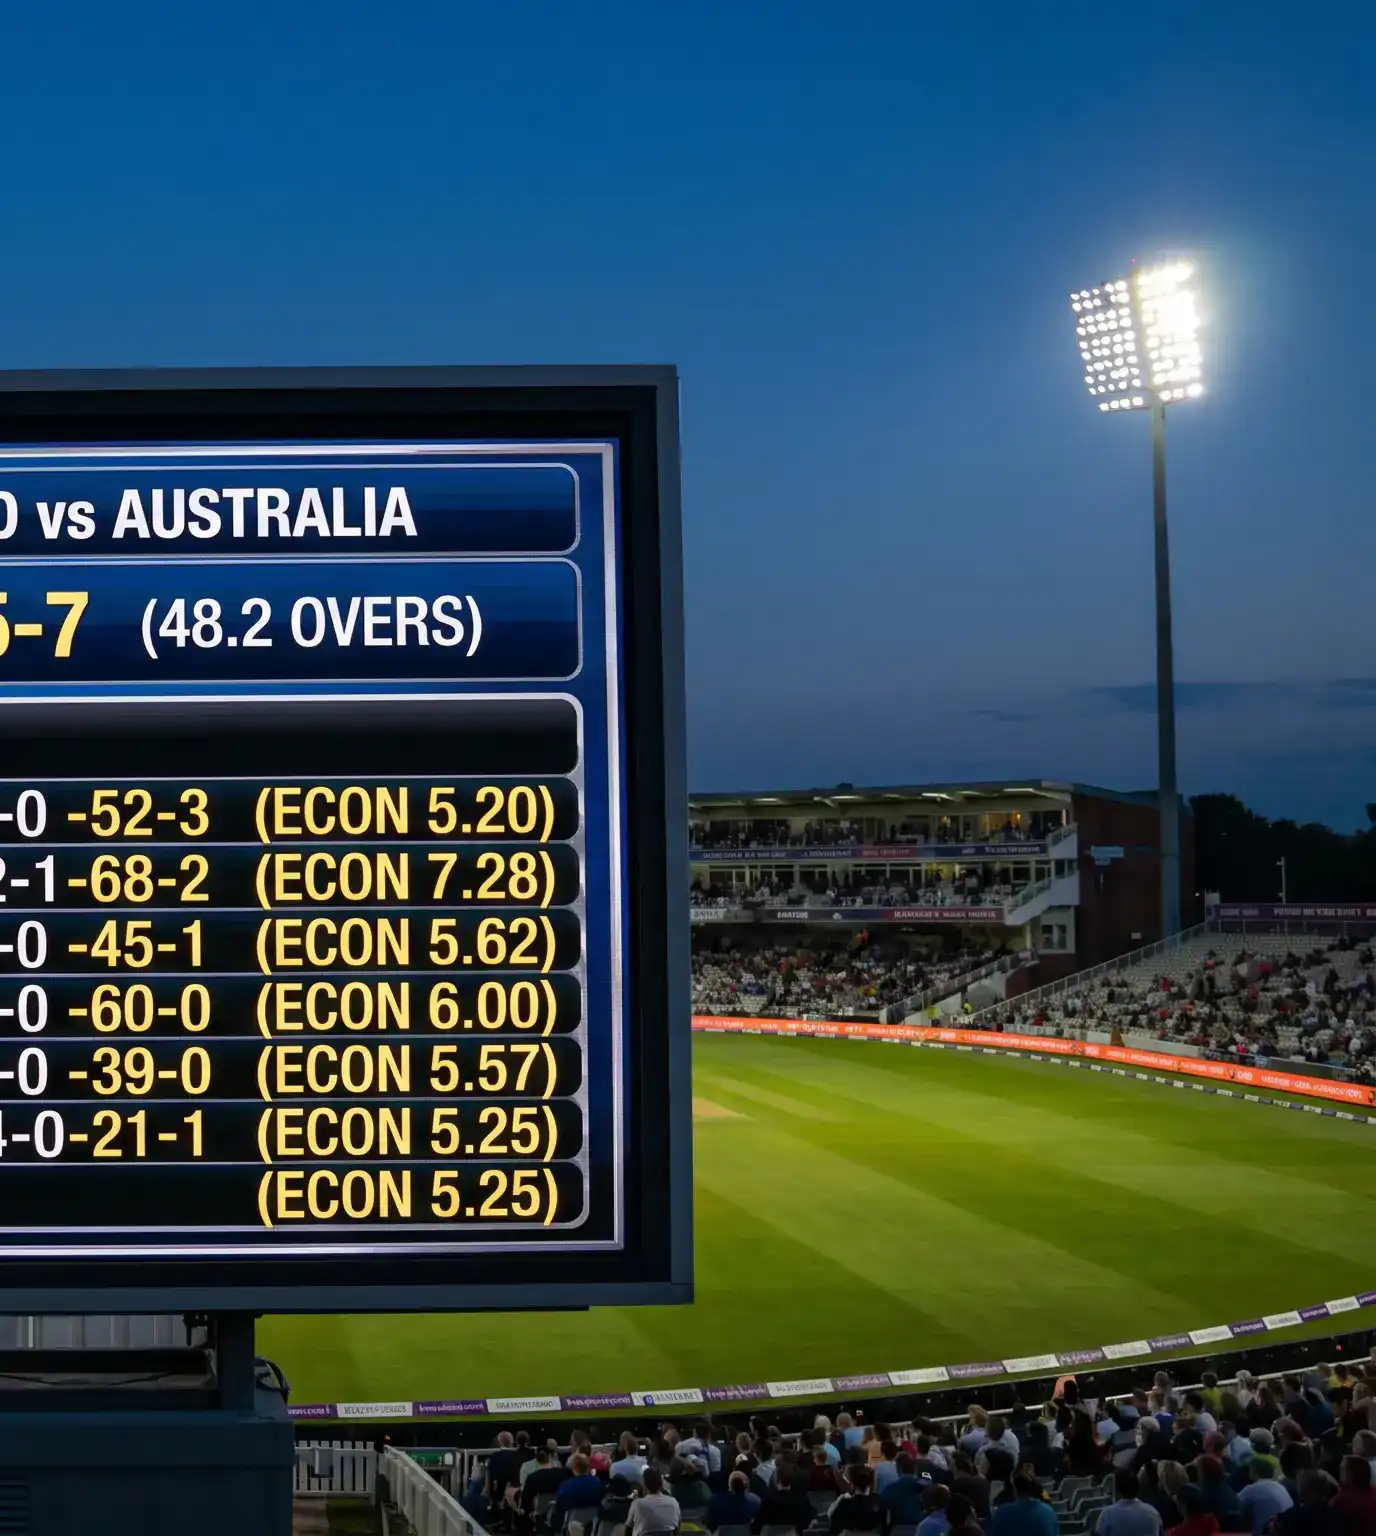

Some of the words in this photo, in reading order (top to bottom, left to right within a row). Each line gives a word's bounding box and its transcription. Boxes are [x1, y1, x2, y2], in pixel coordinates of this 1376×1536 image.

[35, 500, 96, 540] vs
[111, 486, 418, 539] AUSTRALIA
[141, 597, 273, 660] (48.2
[290, 594, 483, 657] OVERS)
[255, 786, 409, 842] (ECON
[427, 785, 555, 842] 5.20)
[255, 852, 409, 909] (ECON
[427, 850, 555, 909] 7.28)
[256, 917, 411, 973] (ECON
[429, 915, 556, 973] 5.62)
[256, 981, 410, 1037] (ECON
[429, 979, 557, 1037] 6.00)
[257, 1044, 410, 1101] (ECON
[430, 1042, 557, 1100] 5.57)
[257, 1106, 412, 1164] (ECON
[430, 1105, 558, 1163] 5.25)
[257, 1169, 412, 1227] (ECON
[430, 1168, 559, 1227] 5.25)
